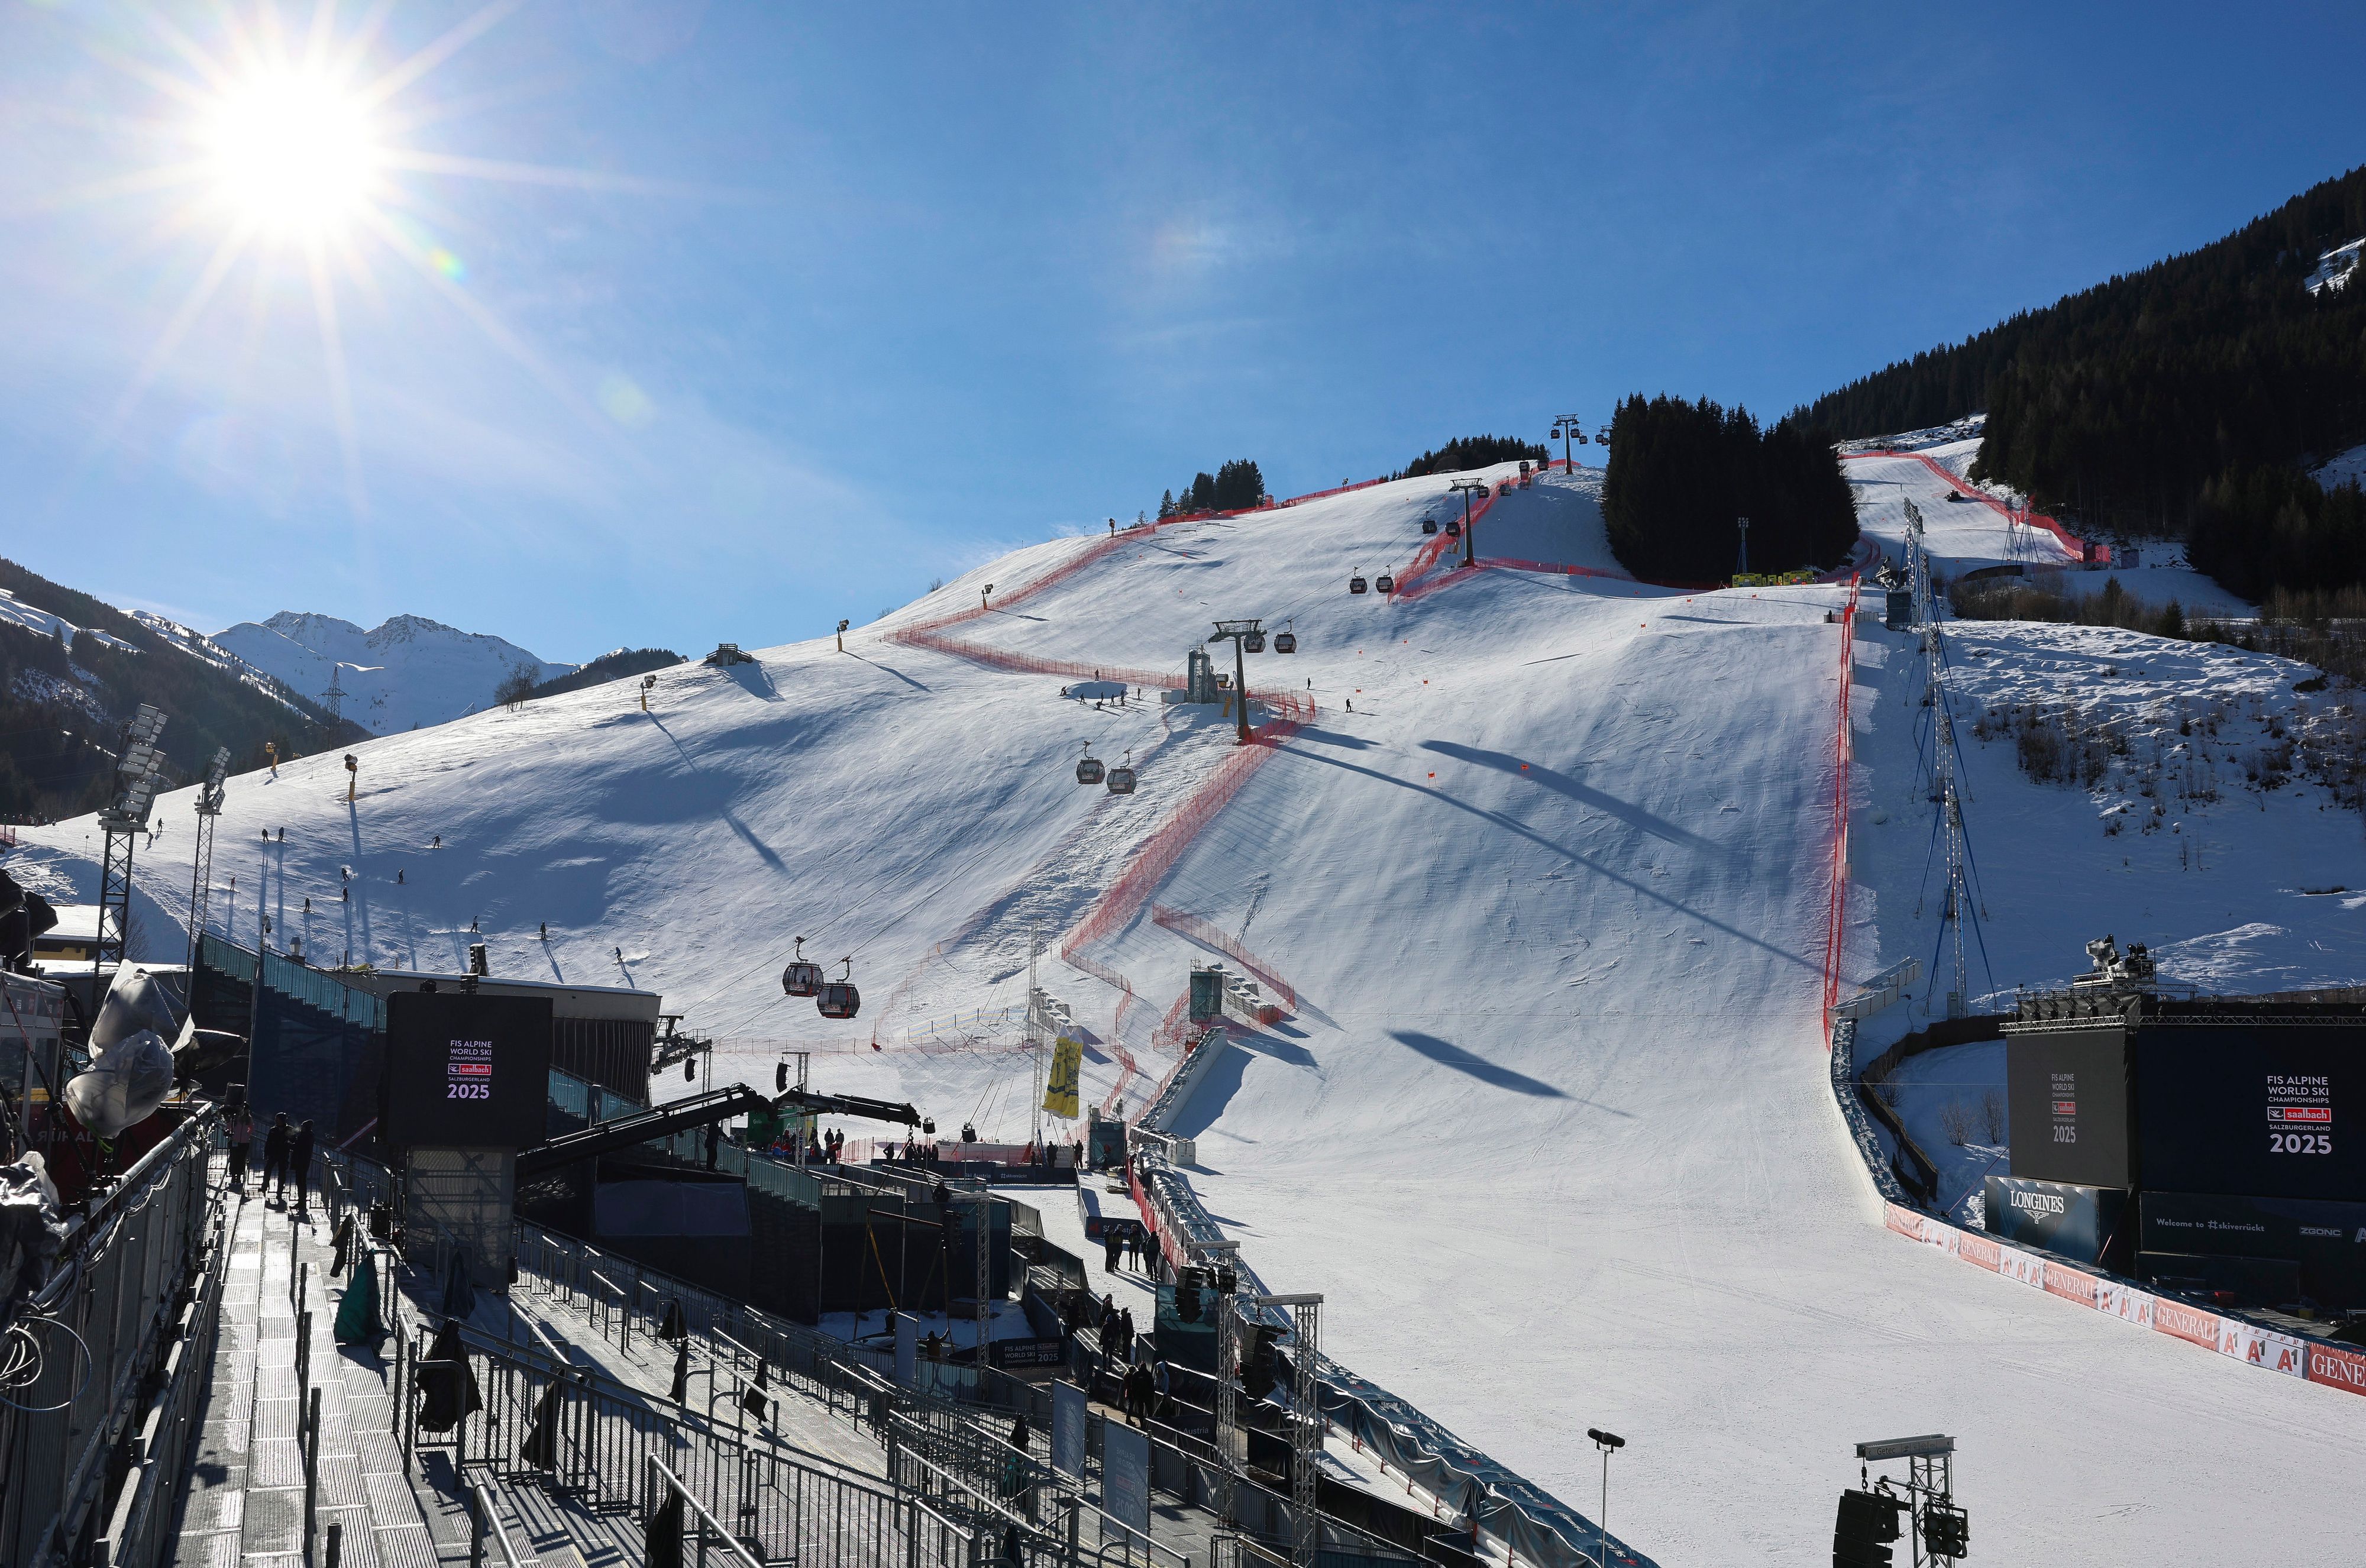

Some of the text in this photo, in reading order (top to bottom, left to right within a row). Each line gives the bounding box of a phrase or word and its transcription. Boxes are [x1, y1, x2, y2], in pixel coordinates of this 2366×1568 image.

[461, 1065, 489, 1073] saalbach
[2267, 1075, 2328, 1085] FIS ALPINE
[447, 1084, 490, 1099] 2025
[2268, 1086, 2329, 1096] WORLD SKI
[2287, 1108, 2327, 1119] saalbach
[2053, 1125, 2076, 1143] 2025
[2270, 1133, 2332, 1155] 2025
[2010, 1190, 2064, 1214] LONGINES
[2156, 1218, 2192, 1227] Welcome
[2207, 1220, 2265, 1231] #skiverrückt
[2300, 1227, 2341, 1236] ZGONC
[1887, 1209, 1922, 1235] GENERALI
[1961, 1238, 1998, 1265] GENERALI
[2047, 1269, 2095, 1301] GENERALI
[2101, 1291, 2113, 1311] A1
[2137, 1304, 2150, 1324] A1
[2157, 1306, 2216, 1342] GENERALI
[2223, 1332, 2238, 1354] A1
[2245, 1340, 2266, 1362] A1
[2277, 1348, 2298, 1372] A1
[1037, 1353, 1059, 1362] 2025
[1877, 1447, 1896, 1455] Getec
